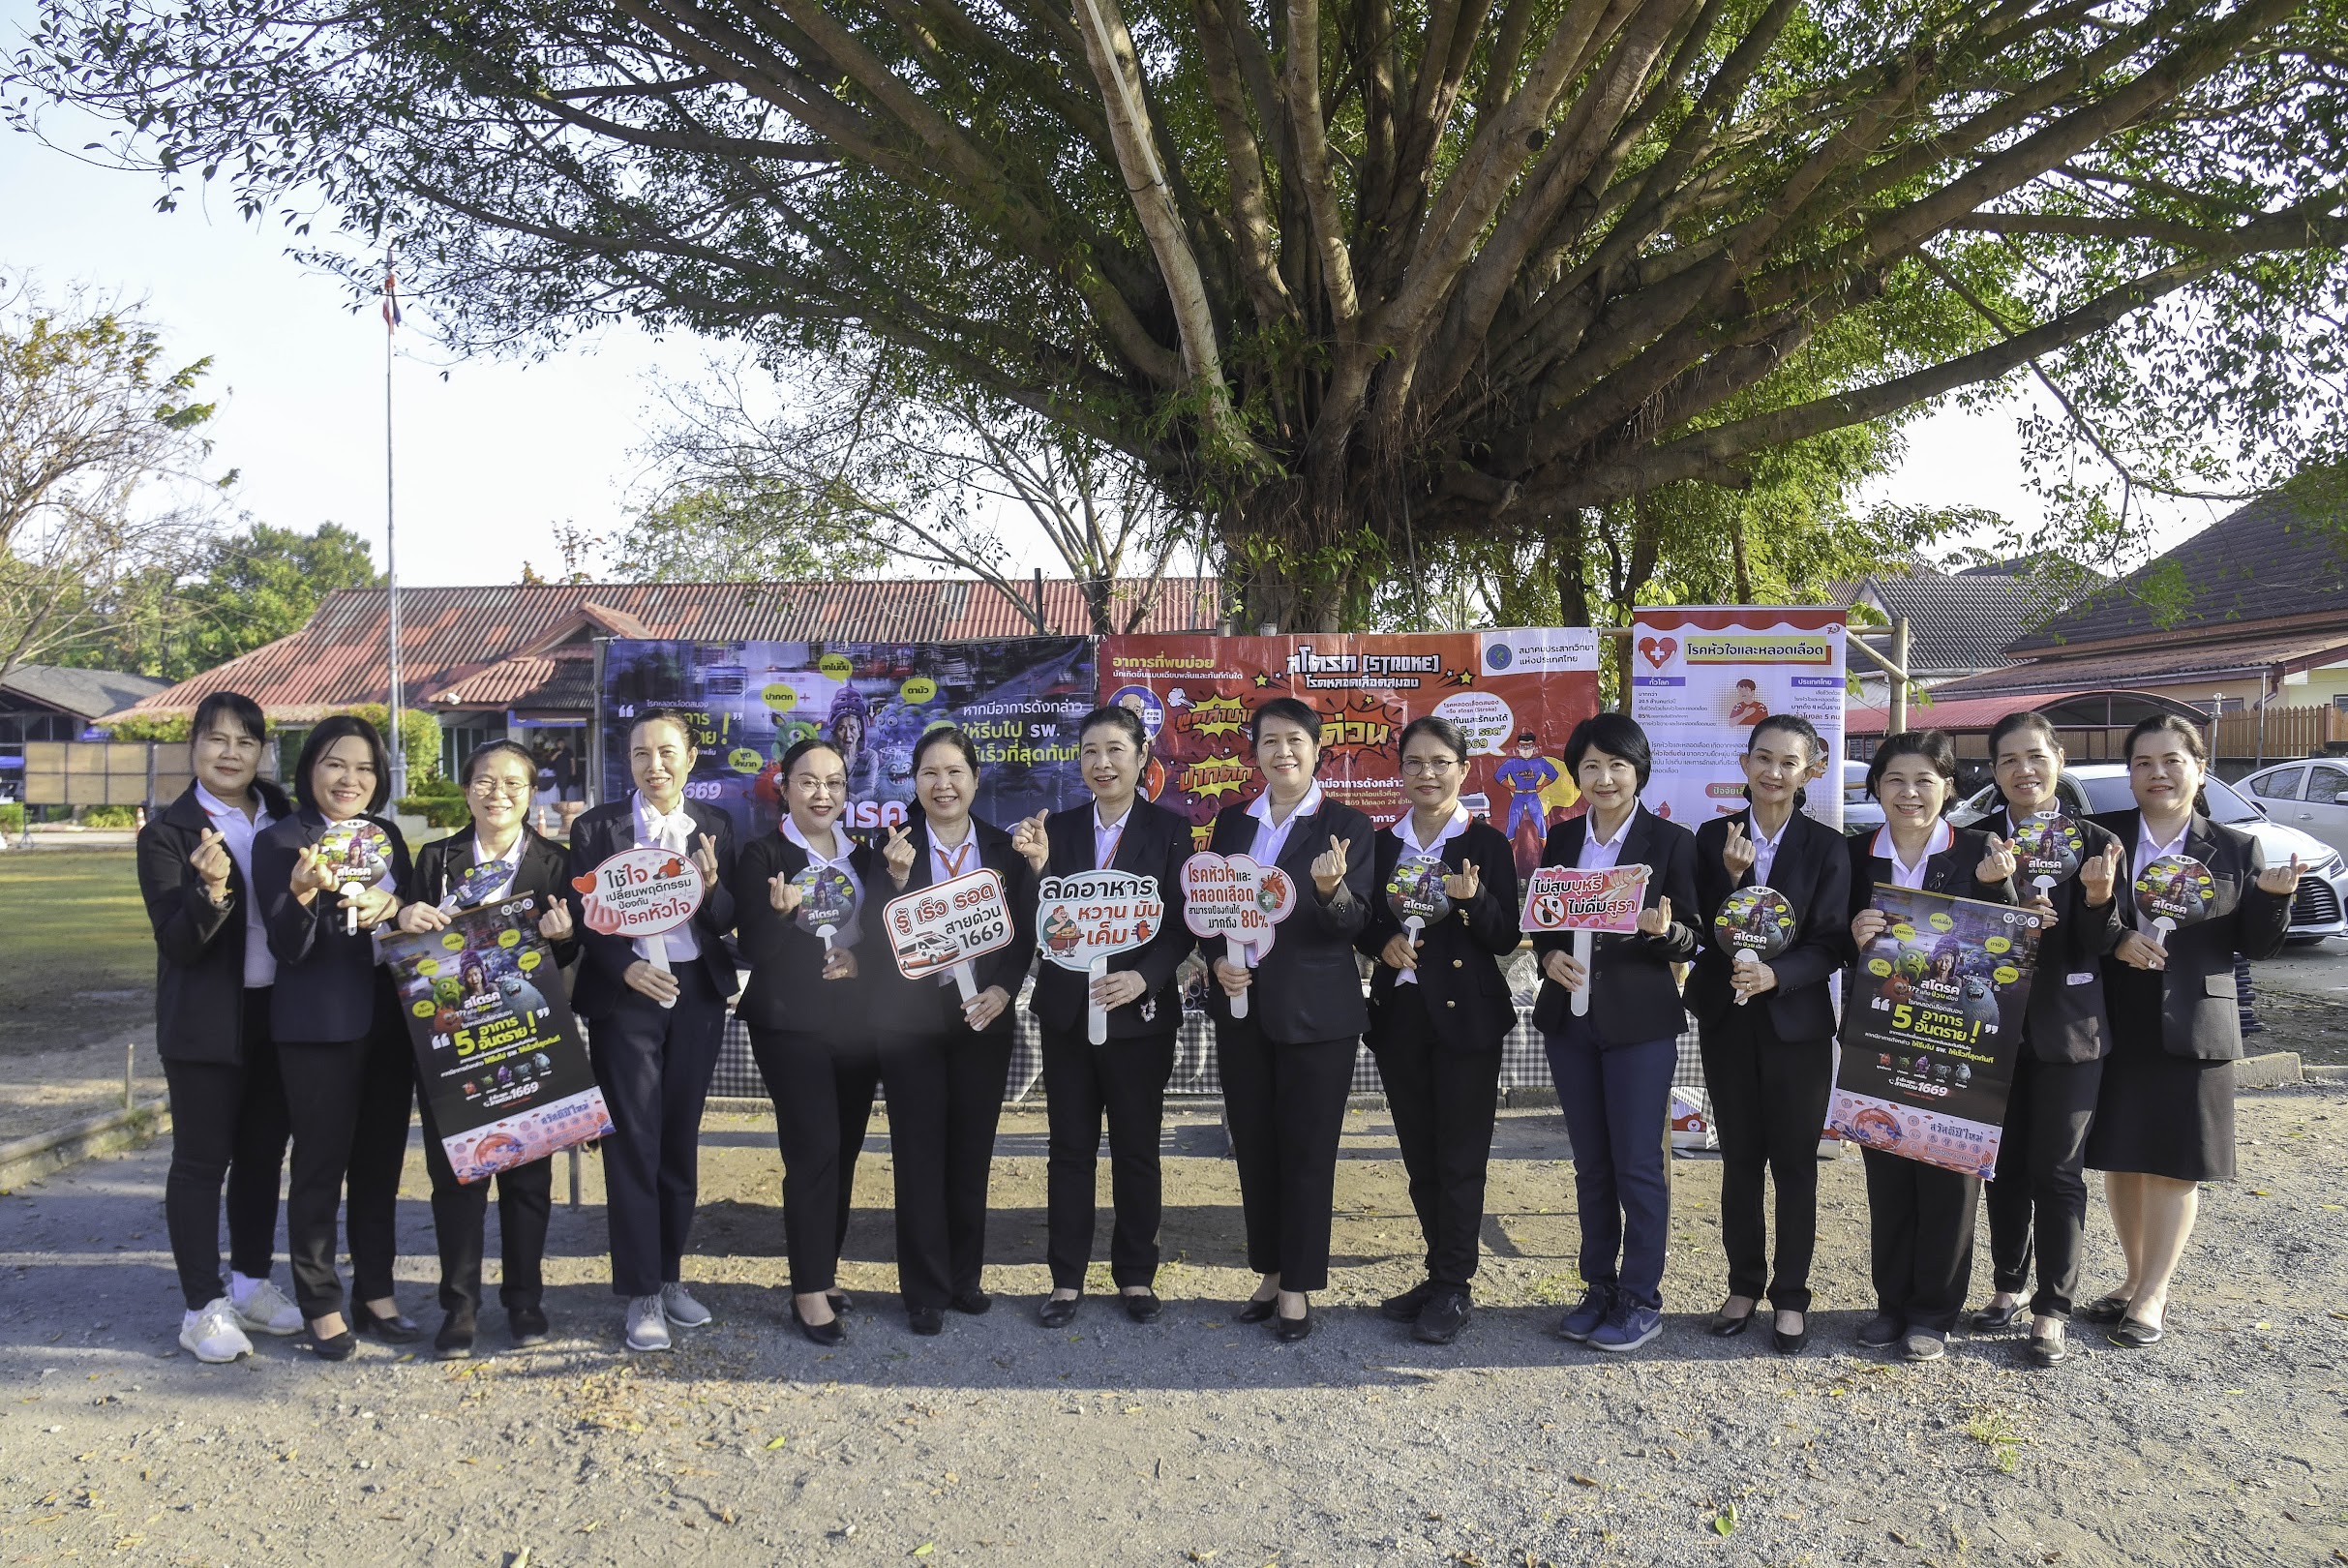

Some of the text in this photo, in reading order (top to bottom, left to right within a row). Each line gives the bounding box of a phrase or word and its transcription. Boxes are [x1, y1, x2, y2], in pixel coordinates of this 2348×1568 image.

[1519, 643, 1594, 654] สมาคมประสาทวิทยา
[1687, 642, 1823, 655] โรคหัวใจและหลอดเลือด
[1113, 650, 1215, 668] อาการที่พบบ่อย
[1520, 654, 1579, 665] แห่งประเทศไทย
[907, 685, 929, 694] ตามัว
[963, 699, 1082, 715] หากมีอาการดังกล่าว
[1030, 724, 1061, 738] รพ.
[683, 782, 723, 799] 669
[604, 863, 648, 890] ใช้ใจ
[1188, 862, 1251, 883] โรคหัวใจและ
[606, 878, 692, 902] เปลี่ยนพฤติกรรม
[1043, 880, 1154, 900] ลดอาหาร
[1190, 885, 1254, 903] หลอดเลือด
[1533, 872, 1603, 896] ไม่สูบบุหรี่
[618, 897, 649, 910] ป้องกัน
[620, 897, 691, 926] โรคหัวใจ
[894, 883, 996, 936] รู้ เร็ว รอด
[1077, 900, 1160, 920] หวาน มัน
[1189, 904, 1241, 915] สามารถป้องกันได้
[1567, 894, 1638, 918] ไม่ดื่มสุรา
[945, 906, 1002, 935] สายด่วน
[1241, 910, 1269, 929] 80%
[959, 921, 1005, 949] 1669
[1087, 920, 1128, 945] เค็ม
[1920, 980, 1960, 996] สโตรค
[478, 1016, 519, 1036] อาการ
[1891, 1004, 1913, 1029] 5
[1922, 1010, 1964, 1027] อาการ
[477, 1026, 528, 1050] อันตราย
[1914, 1019, 1968, 1042] อันตราย
[453, 1029, 476, 1056] 5
[510, 1081, 539, 1100] 1669
[1917, 1082, 1948, 1097] 1669
